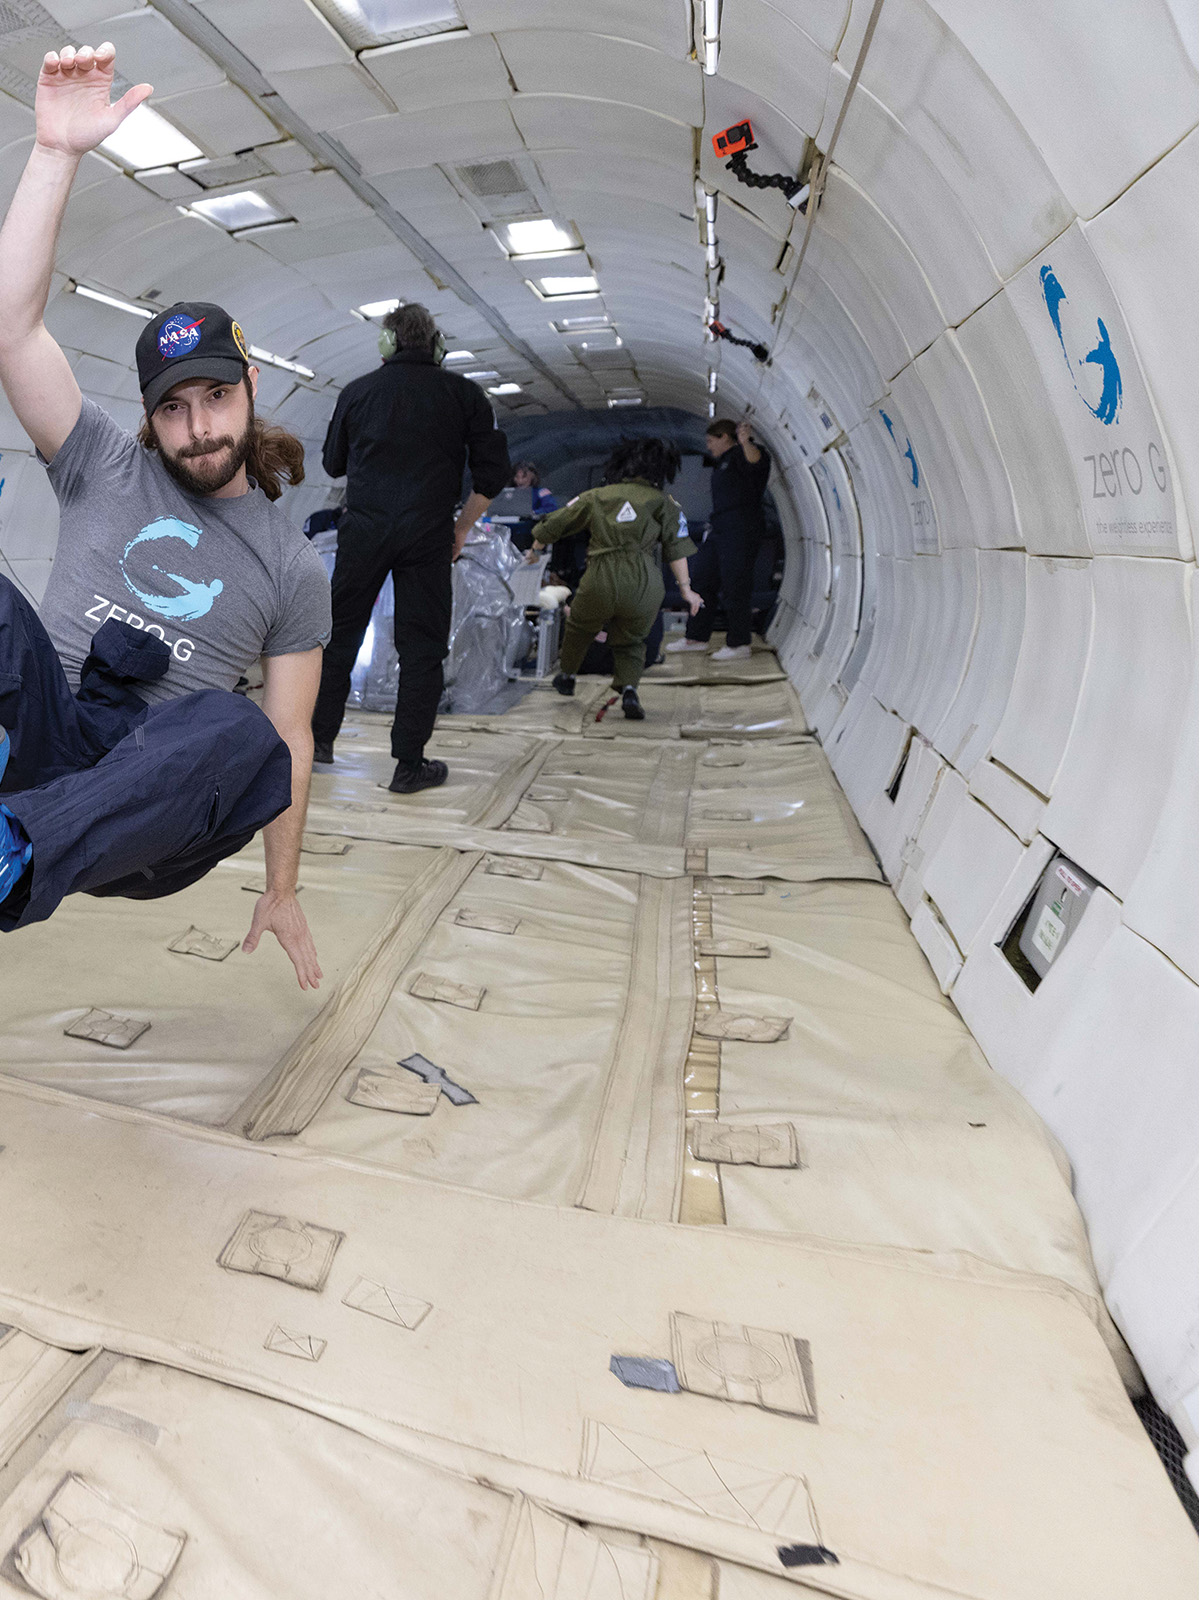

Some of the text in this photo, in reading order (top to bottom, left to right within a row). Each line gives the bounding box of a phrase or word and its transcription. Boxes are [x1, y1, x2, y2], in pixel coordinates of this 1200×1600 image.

[160, 327, 199, 347] NASA
[1083, 442, 1167, 499] zero G
